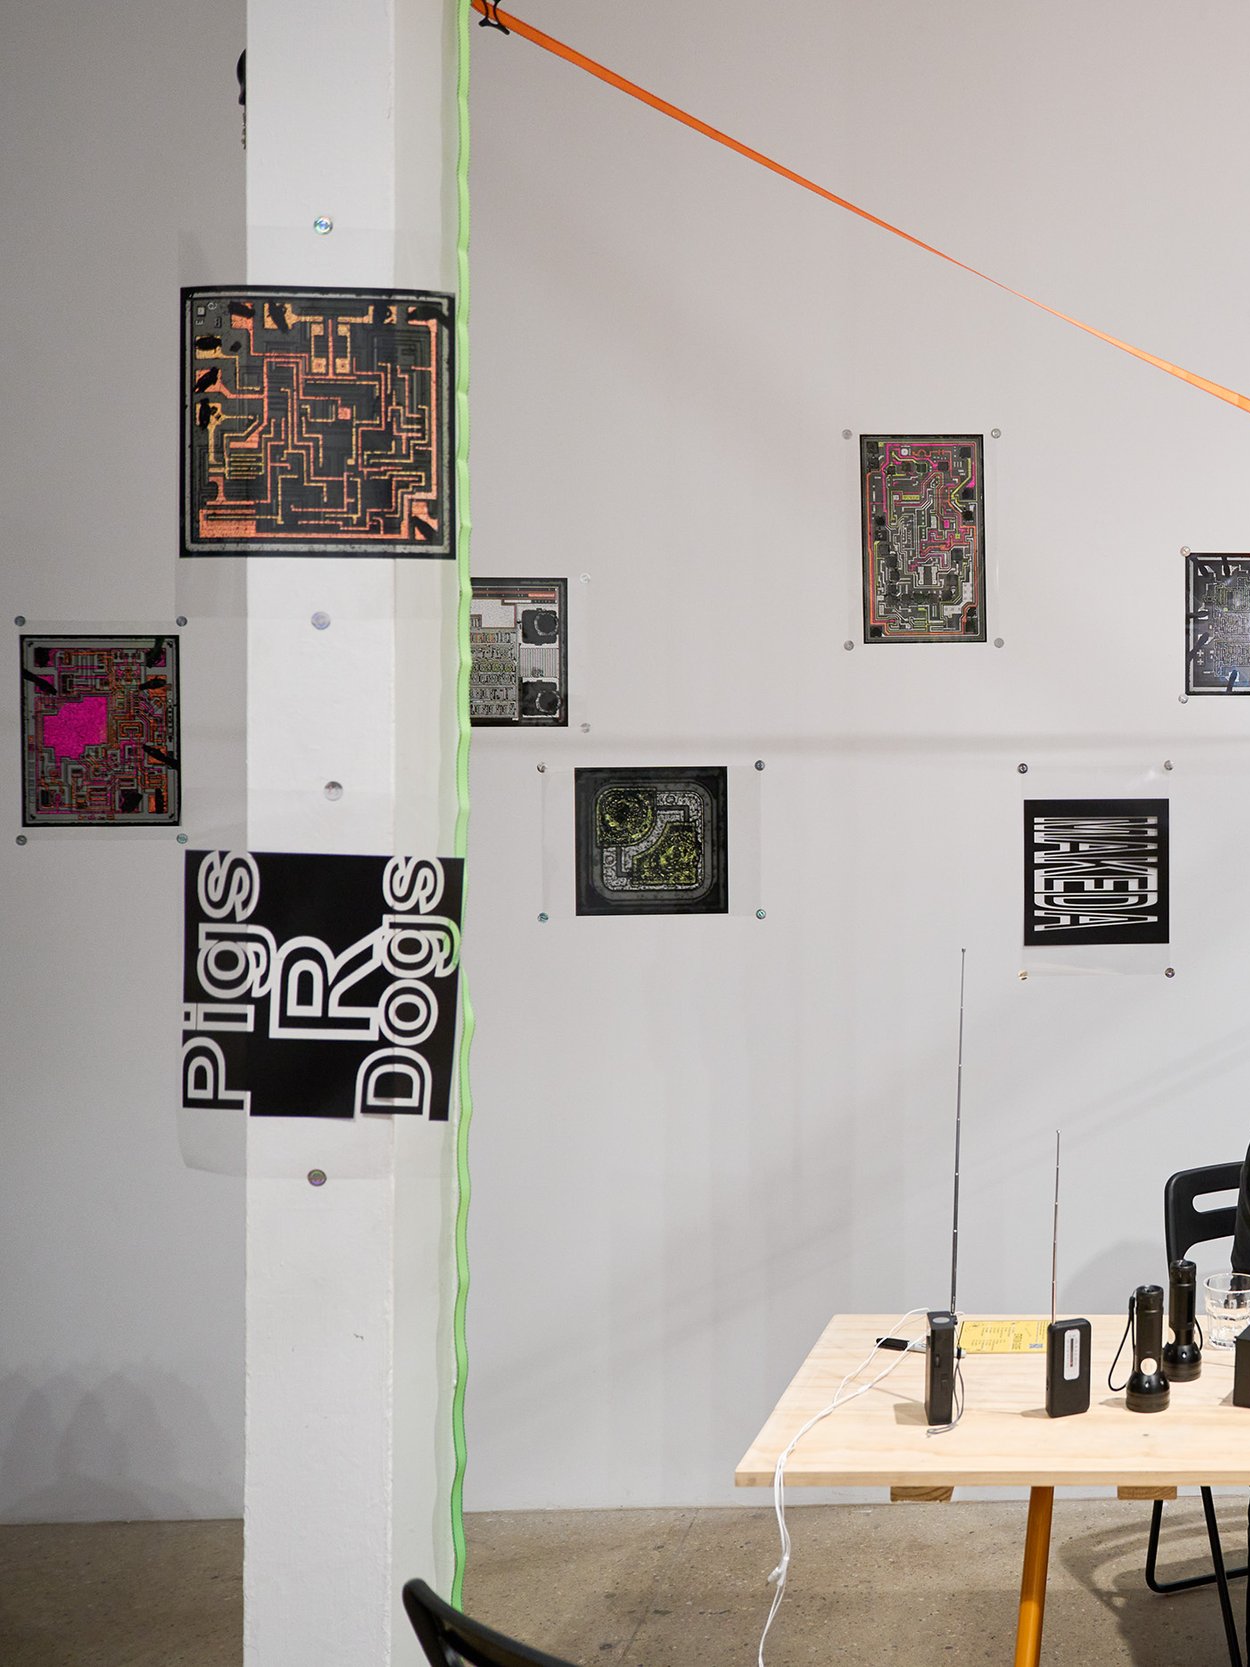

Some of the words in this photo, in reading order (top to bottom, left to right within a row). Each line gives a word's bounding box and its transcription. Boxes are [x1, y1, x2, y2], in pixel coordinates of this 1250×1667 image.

[1034, 816, 1158, 932] MAKEDA
[182, 850, 278, 1109] Pigs
[268, 935, 389, 1041] R
[353, 855, 461, 1121] Dogs
